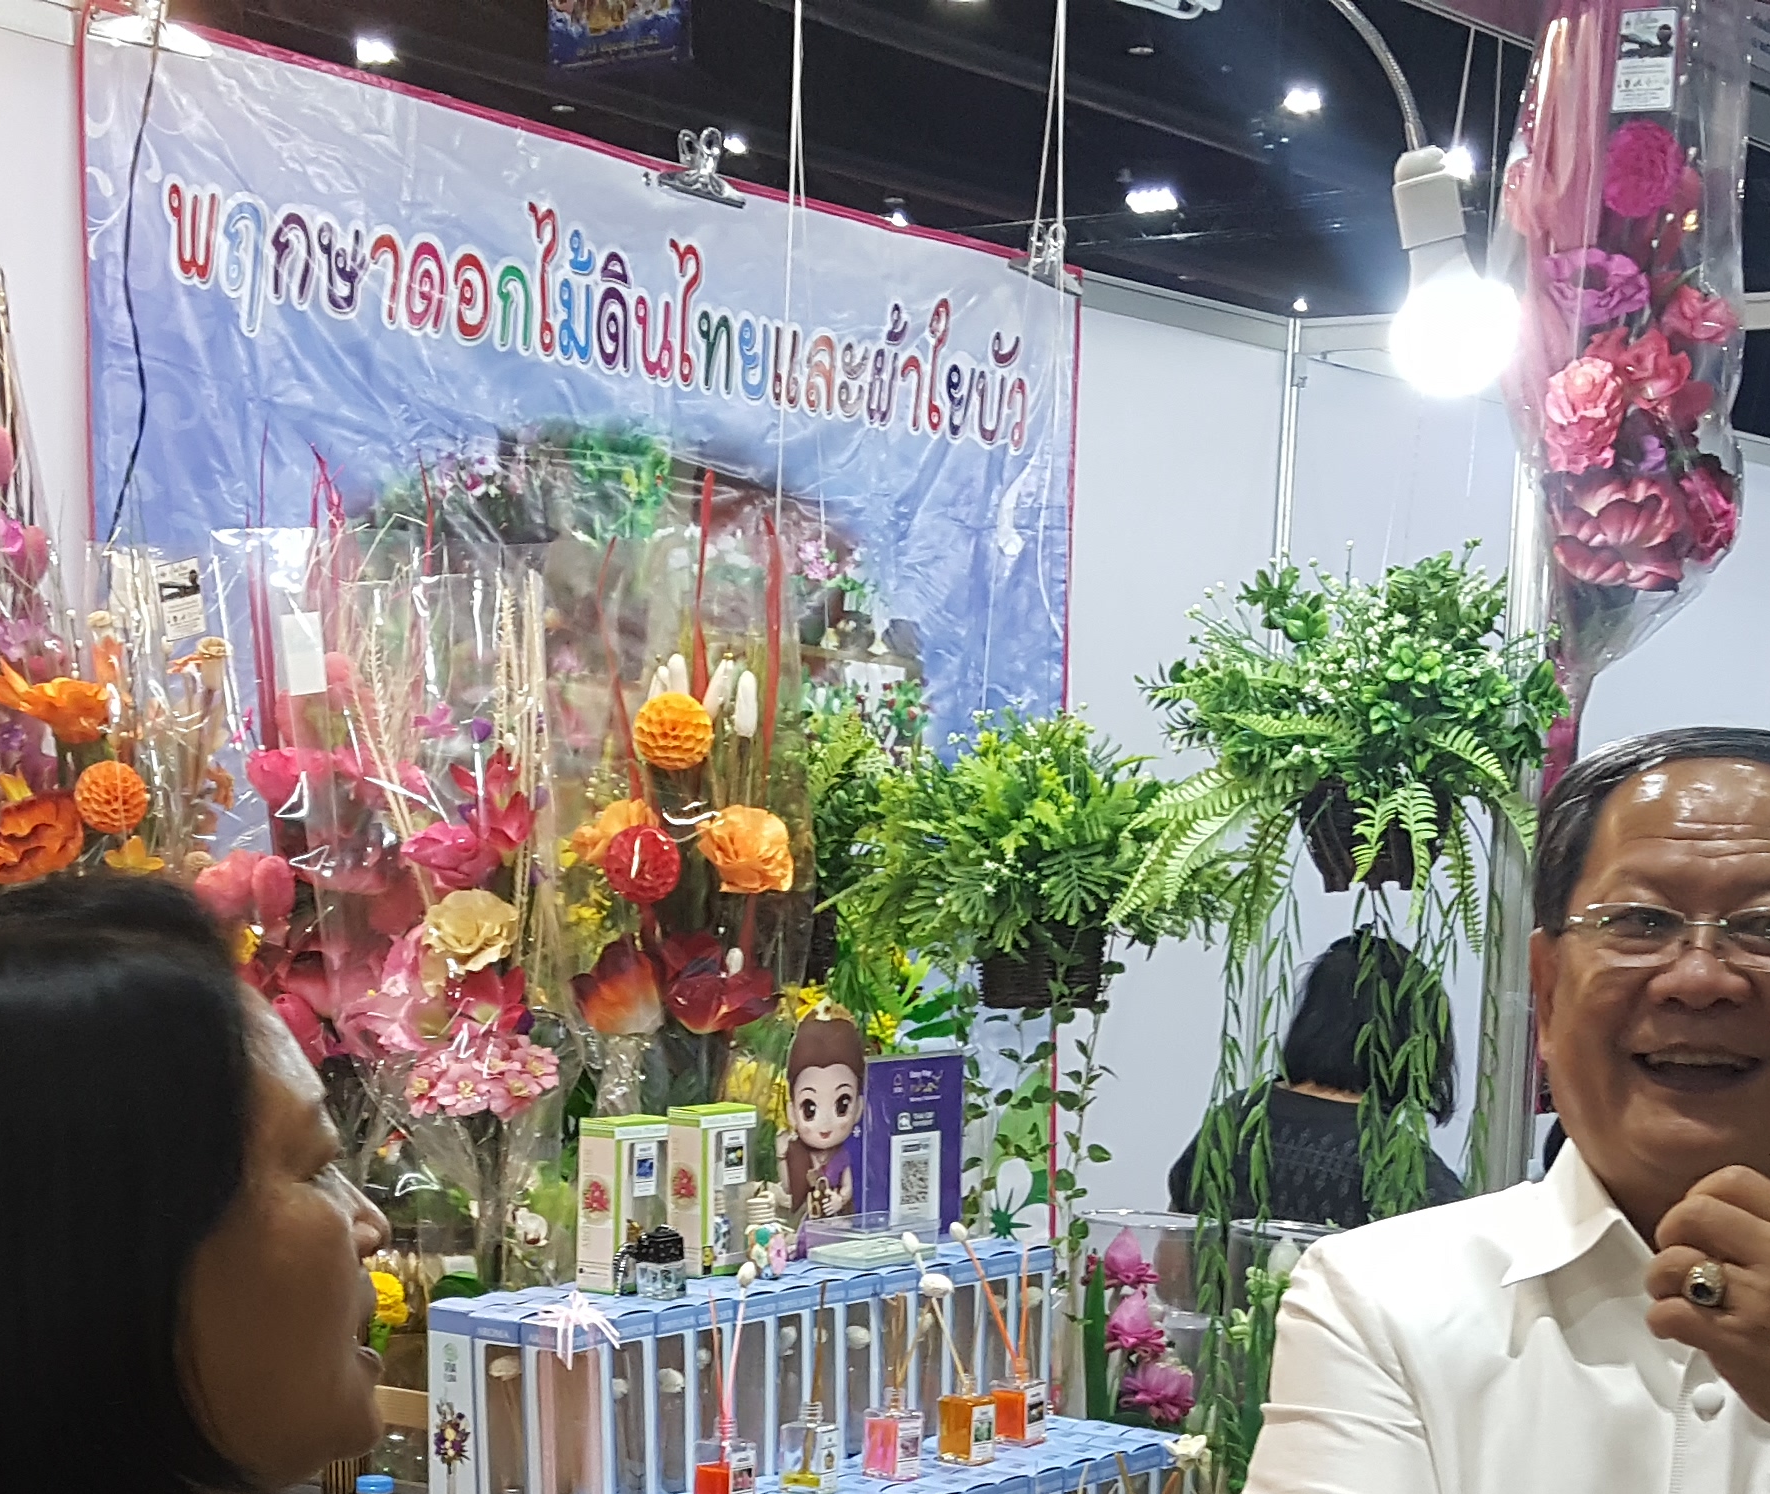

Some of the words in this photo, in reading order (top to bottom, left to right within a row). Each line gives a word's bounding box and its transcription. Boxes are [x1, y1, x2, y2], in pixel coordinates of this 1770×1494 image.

[165, 180, 1031, 450] พฤกษาดอกไม้ดินไทยและผ้าใยบัว
